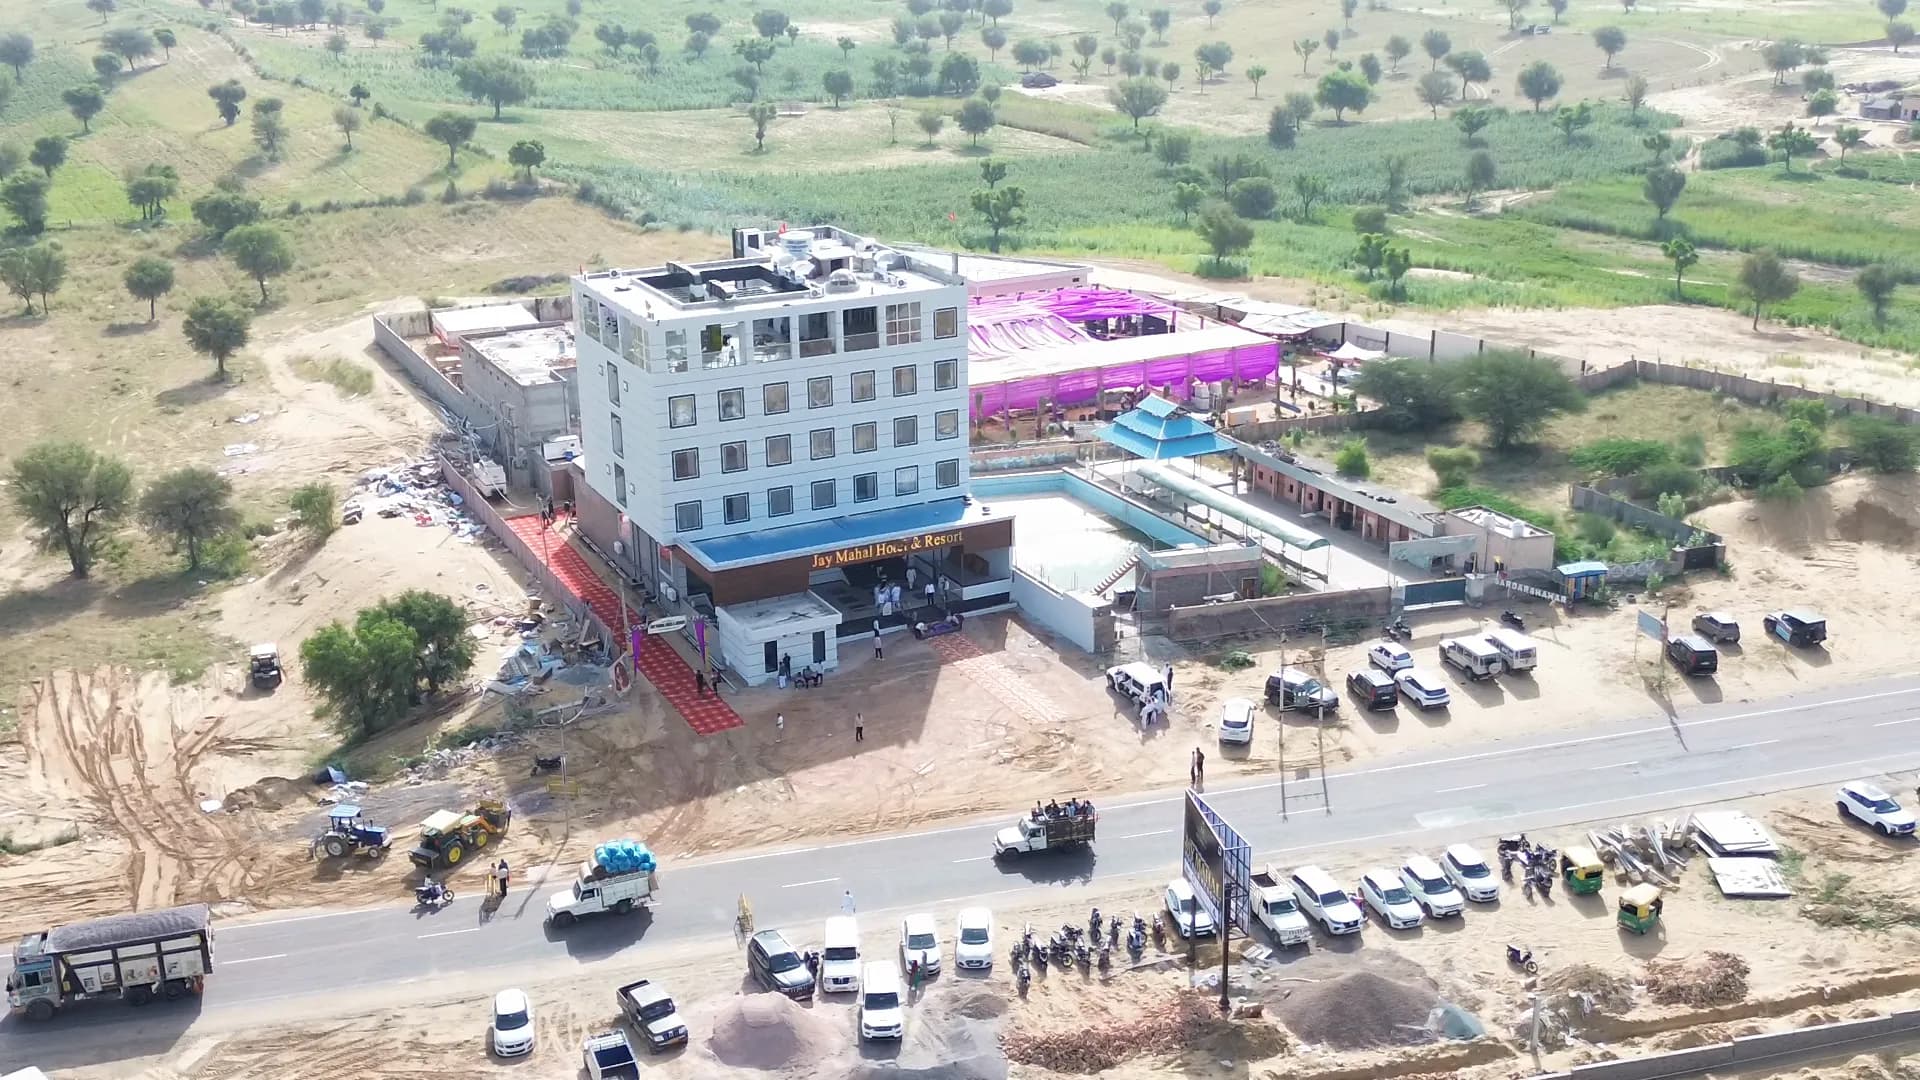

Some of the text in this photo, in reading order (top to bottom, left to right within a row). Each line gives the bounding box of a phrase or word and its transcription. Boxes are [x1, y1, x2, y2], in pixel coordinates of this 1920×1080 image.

[812, 555, 833, 569] Jay
[835, 549, 872, 564] Mahal
[911, 537, 922, 550] &
[924, 531, 963, 547] Resort
